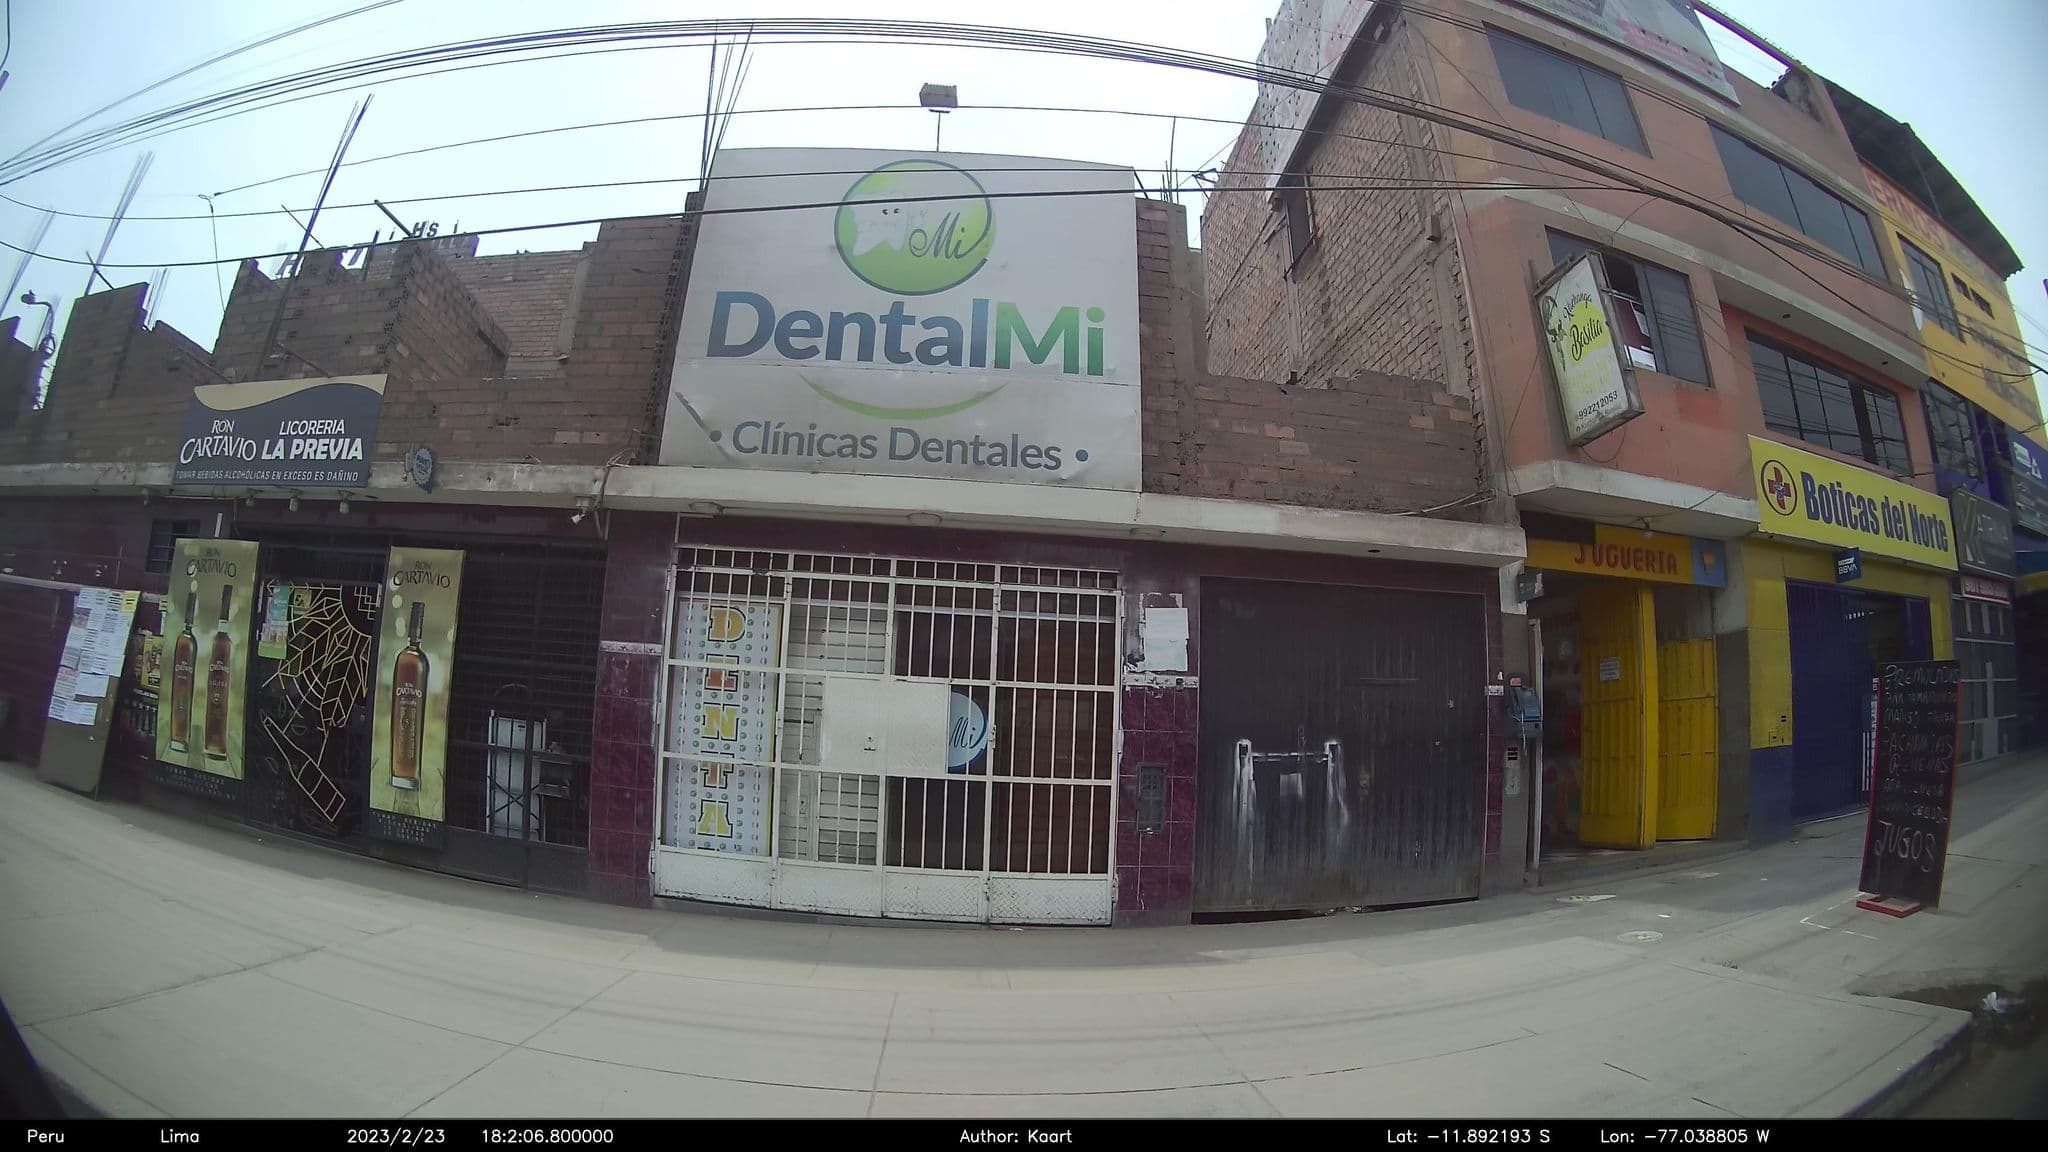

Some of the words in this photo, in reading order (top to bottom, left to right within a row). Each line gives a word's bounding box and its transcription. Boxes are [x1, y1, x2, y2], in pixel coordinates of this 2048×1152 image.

[909, 211, 989, 259] Mi
[211, 419, 235, 434] RON
[279, 418, 345, 436] LICORERIA
[180, 435, 257, 464] CARTAVIO
[261, 439, 285, 460] LA
[289, 437, 363, 461] PREVIA
[732, 421, 878, 460] Clínicas
[888, 426, 1062, 471] Dentales
[271, 470, 281, 480] EN
[283, 470, 313, 481] EXCESO
[314, 471, 325, 481] ES
[327, 469, 359, 482] DAÑINO
[1801, 471, 1879, 536] Boticas
[1881, 496, 1909, 542] del
[1908, 503, 1949, 552] Norte
[186, 559, 237, 578] CARTAVIO
[1574, 543, 1678, 576] JUGUERIA
[393, 570, 451, 589] CARTAVIO
[1875, 820, 1937, 873] JUGOS
